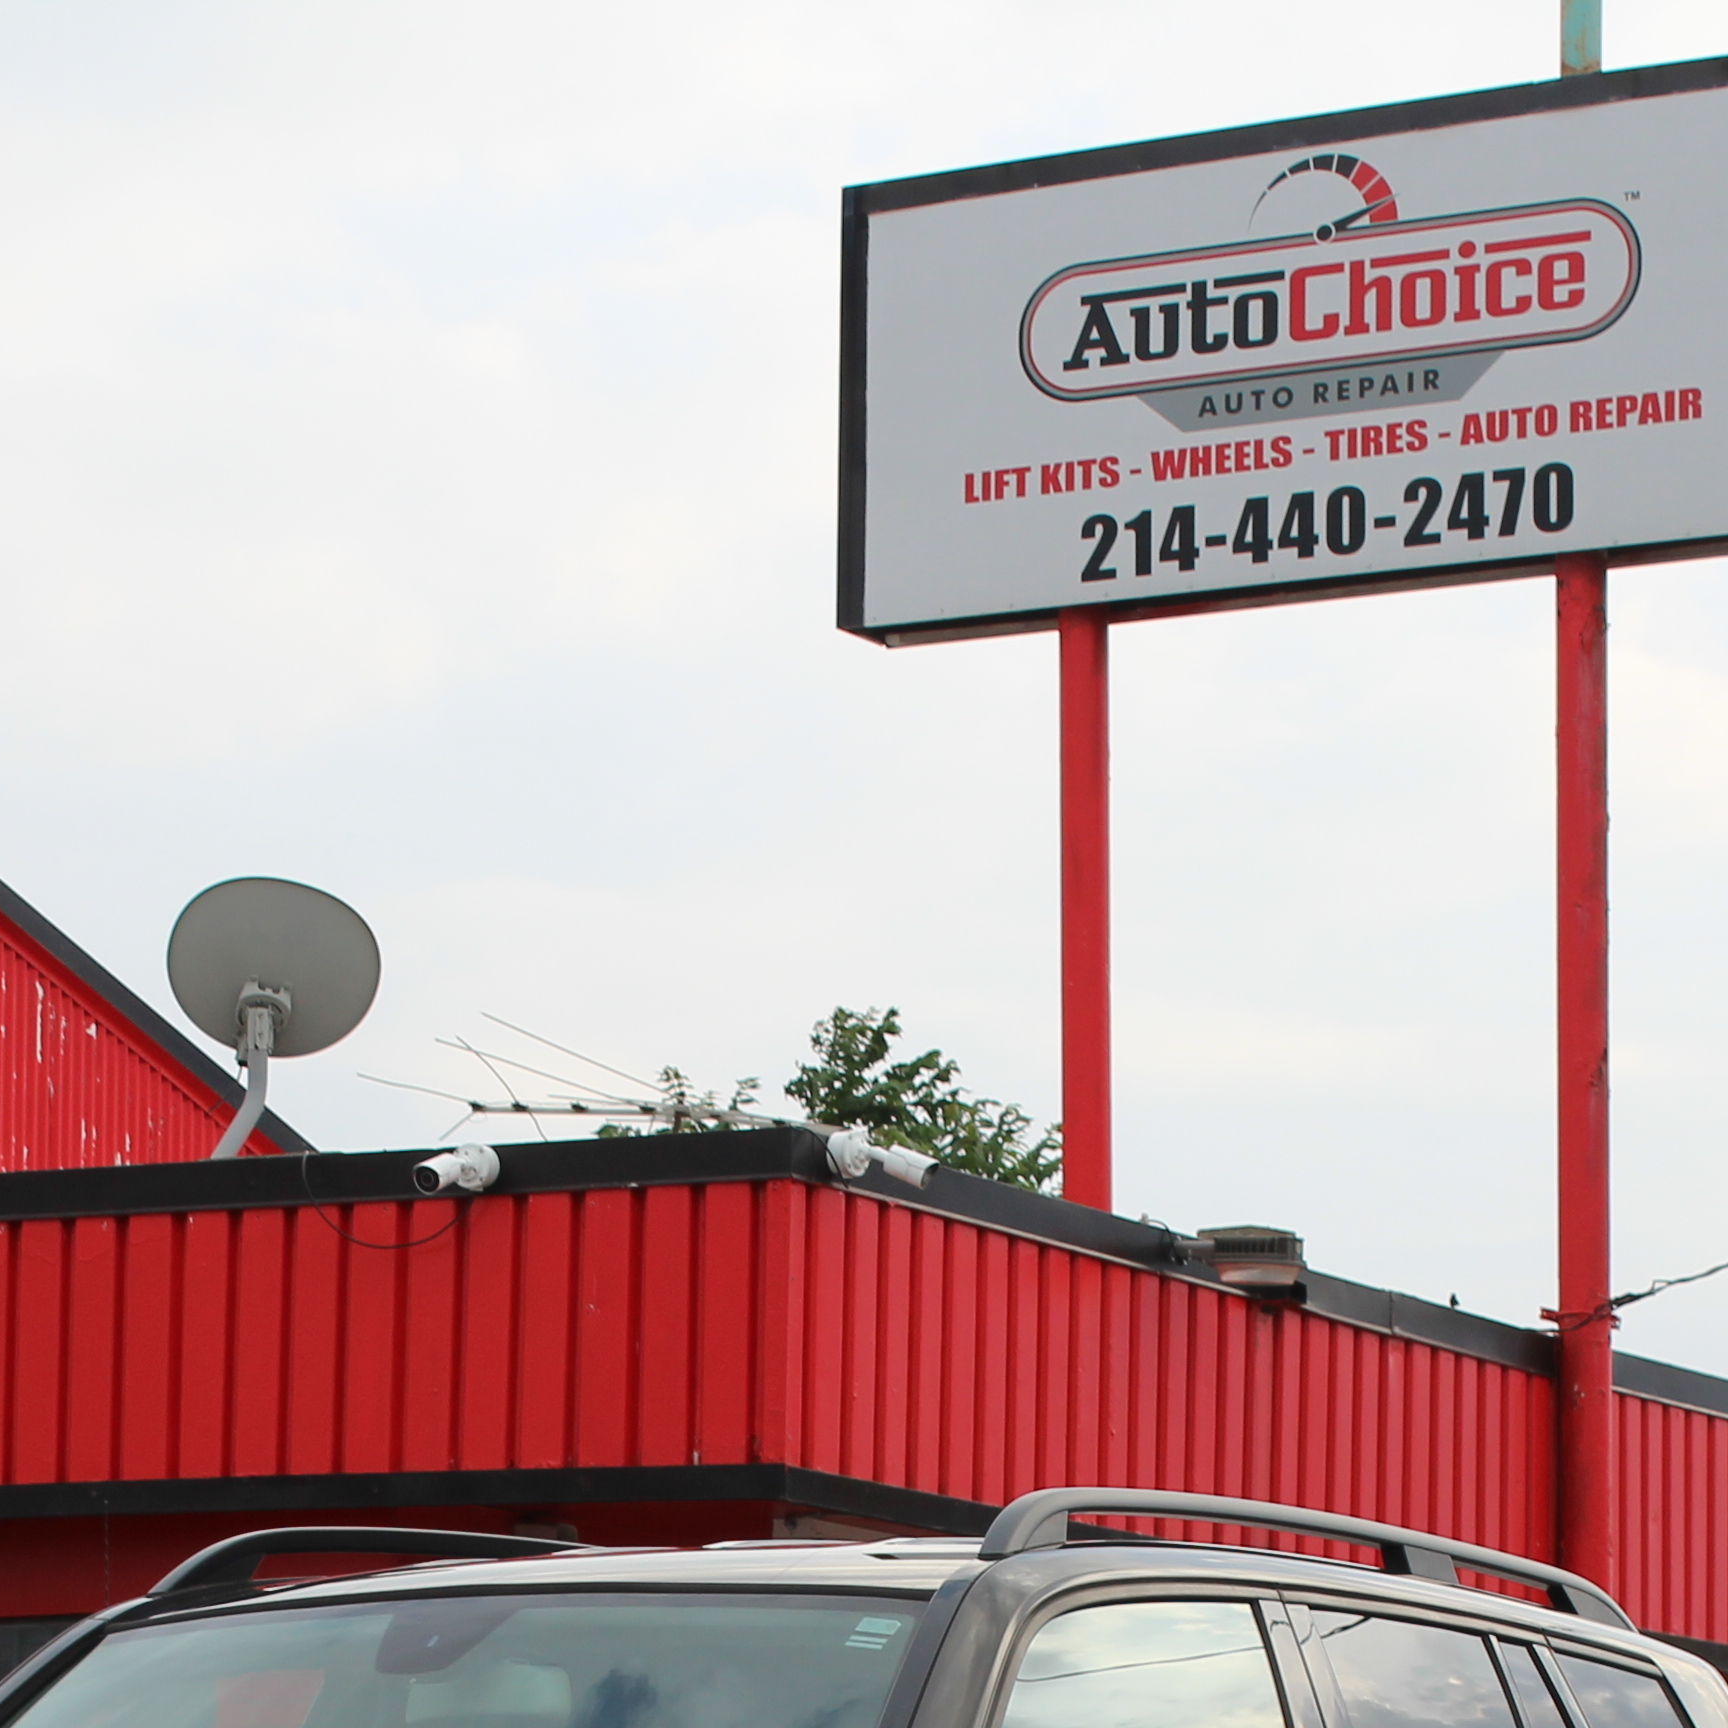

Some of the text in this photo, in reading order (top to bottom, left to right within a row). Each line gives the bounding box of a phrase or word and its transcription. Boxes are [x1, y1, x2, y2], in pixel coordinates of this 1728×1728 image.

[1062, 229, 1593, 372] AutoChoice
[964, 466, 1032, 504] LIFT
[1040, 456, 1121, 495] KITS
[1151, 435, 1293, 483] WHEELS
[1324, 419, 1428, 461] TIRES
[1460, 404, 1559, 446] AUTO
[1569, 387, 1703, 433] REPAIR
[1198, 368, 1442, 417] AUTO REPAIR
[1080, 461, 1574, 583] 214-440-2470
